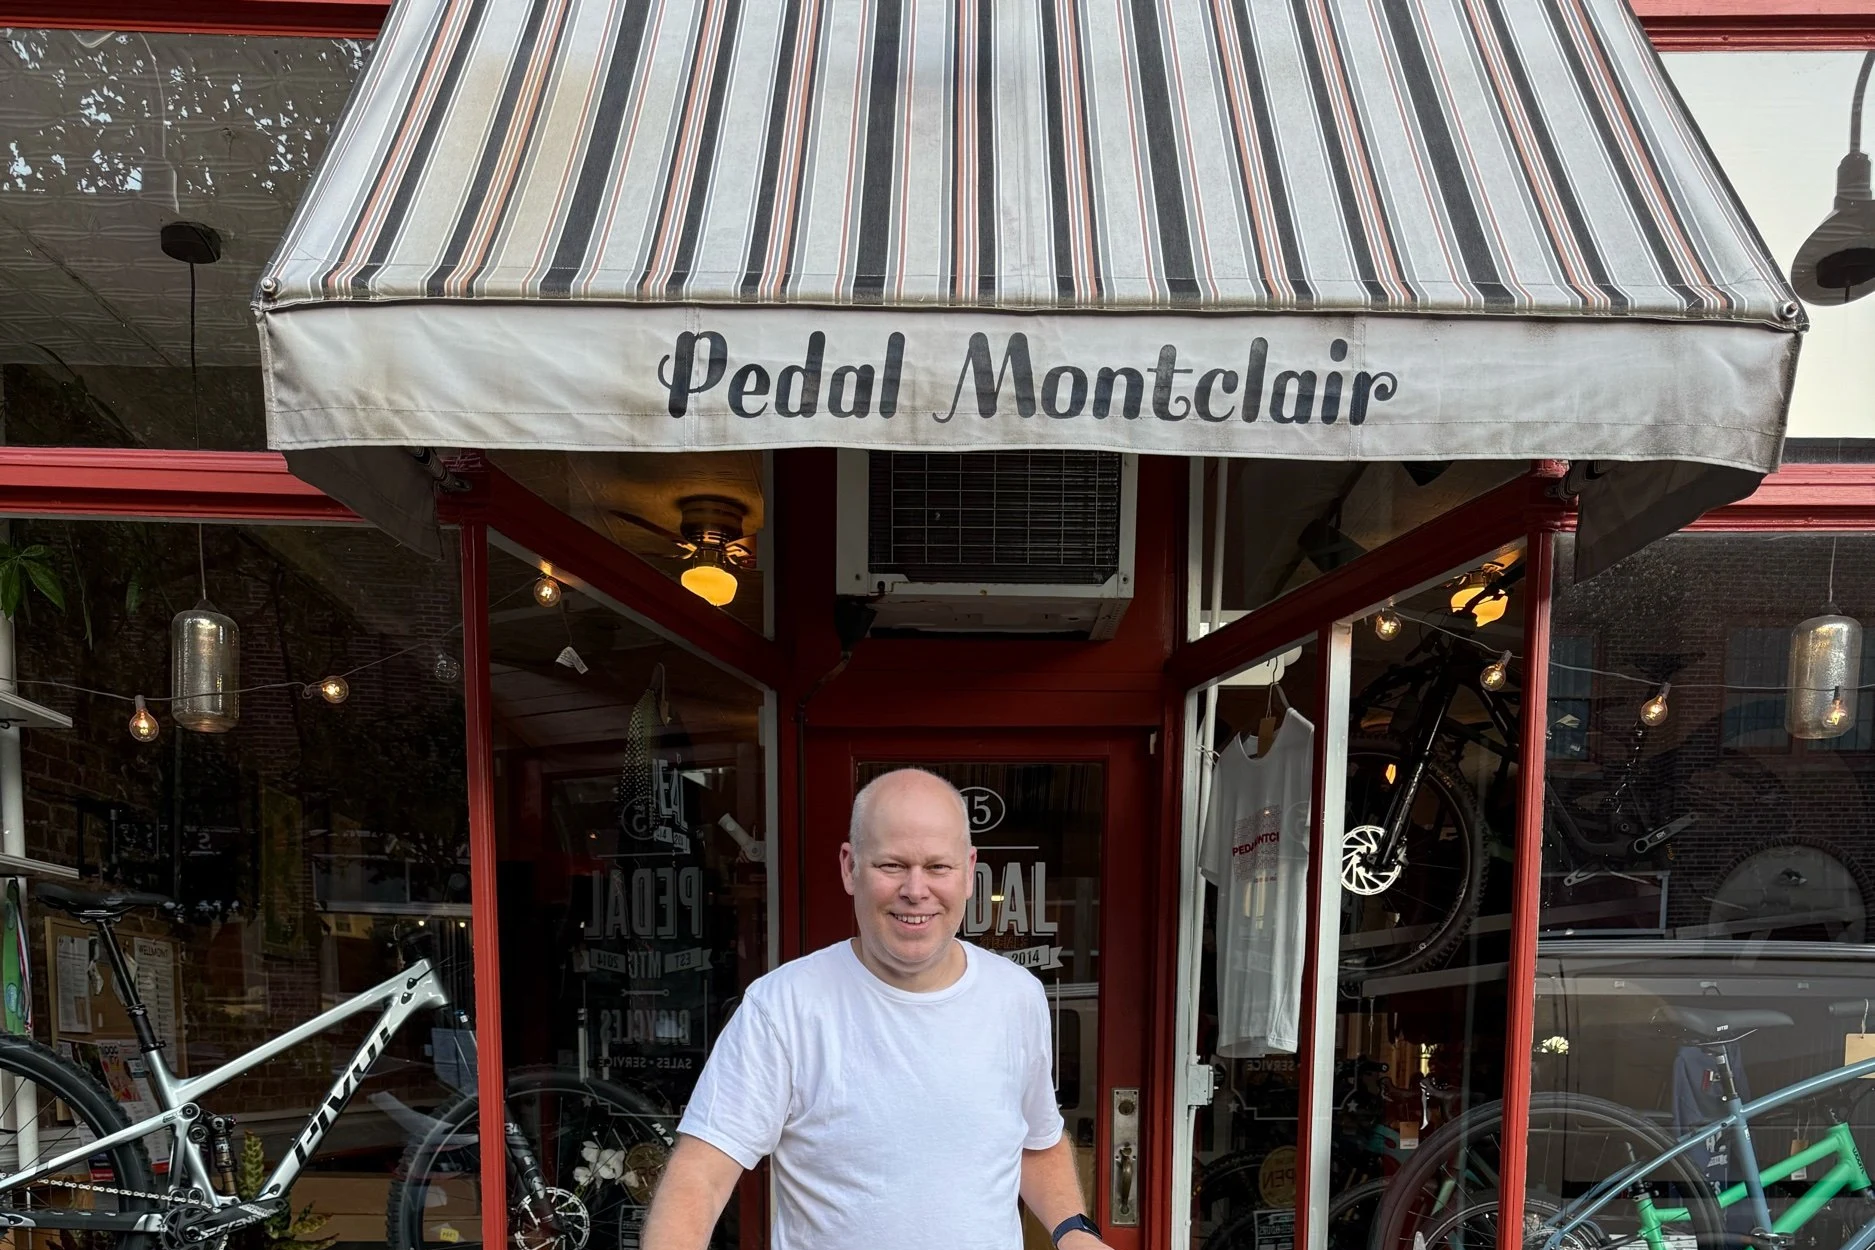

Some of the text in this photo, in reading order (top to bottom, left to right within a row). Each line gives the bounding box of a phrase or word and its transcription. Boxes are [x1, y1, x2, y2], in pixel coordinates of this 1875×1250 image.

[658, 331, 1398, 426] Pedal Montclair
[963, 861, 1059, 936] DAL
[1011, 949, 1040, 965] 2014
